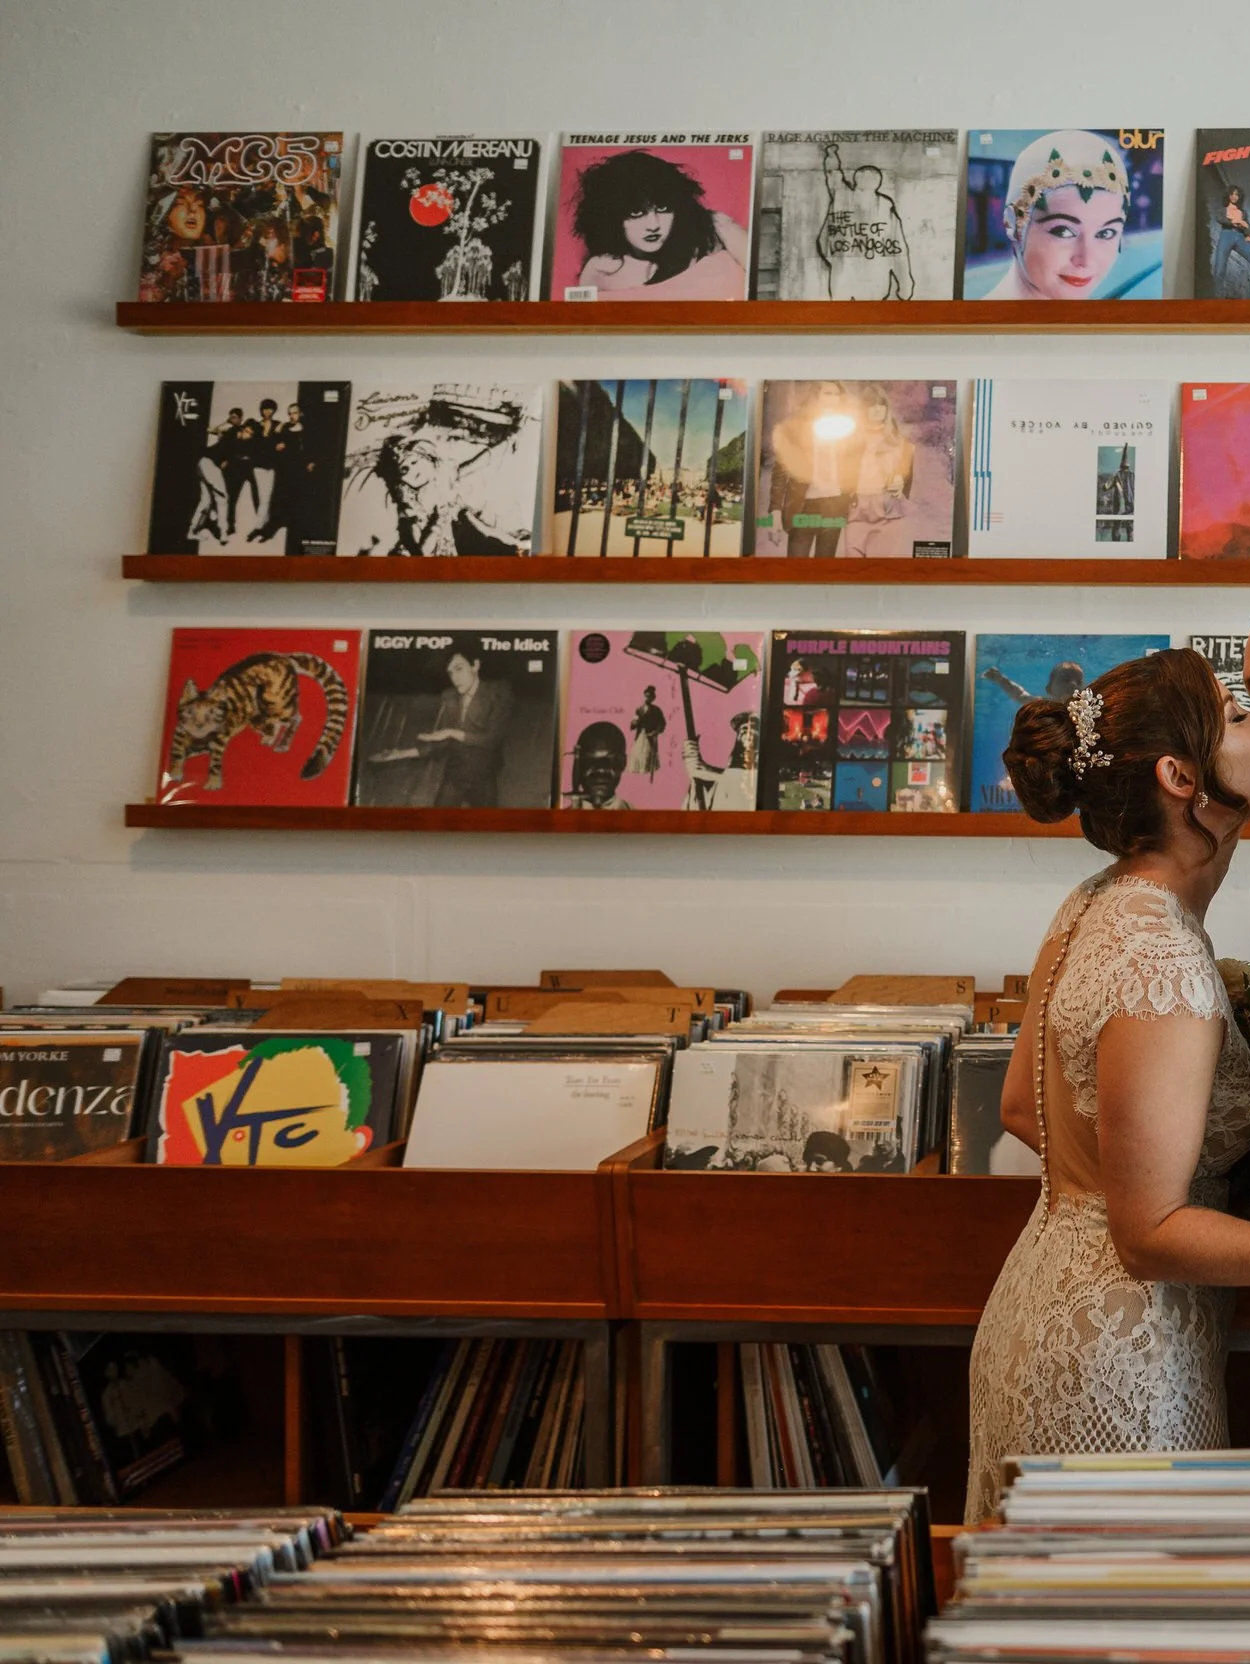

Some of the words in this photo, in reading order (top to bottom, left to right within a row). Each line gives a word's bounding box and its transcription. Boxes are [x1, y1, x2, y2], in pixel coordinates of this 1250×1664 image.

[569, 134, 621, 144] TEENAGE
[623, 134, 657, 144] JESUS
[660, 134, 687, 144] AND
[690, 134, 711, 144] THE
[714, 134, 749, 144] JERKS
[768, 133, 801, 143] RAGE
[804, 133, 861, 143] AGAINST
[863, 132, 890, 143] THE
[892, 132, 956, 143] MACHINE
[1119, 129, 1164, 150] blur
[375, 141, 442, 158] COSTIN
[442, 141, 533, 158] MIEREANU
[170, 134, 320, 186] MC5
[828, 211, 855, 223] THE
[828, 223, 868, 237] BATTLE
[870, 223, 887, 237] OF
[1011, 420, 1061, 429] VOICES
[1073, 421, 1088, 430] BY
[375, 636, 413, 649] IGGY
[416, 636, 453, 650] POP
[481, 637, 511, 651] The
[514, 637, 550, 652] Idiot
[787, 640, 847, 655] PURPLE
[850, 640, 951, 655] MOUNTAINS
[956, 980, 966, 994] S
[443, 987, 456, 1003] Z
[695, 991, 706, 1008] V
[666, 1007, 681, 1023] T
[989, 1007, 1000, 1022] P
[18, 1050, 70, 1062] YORKE
